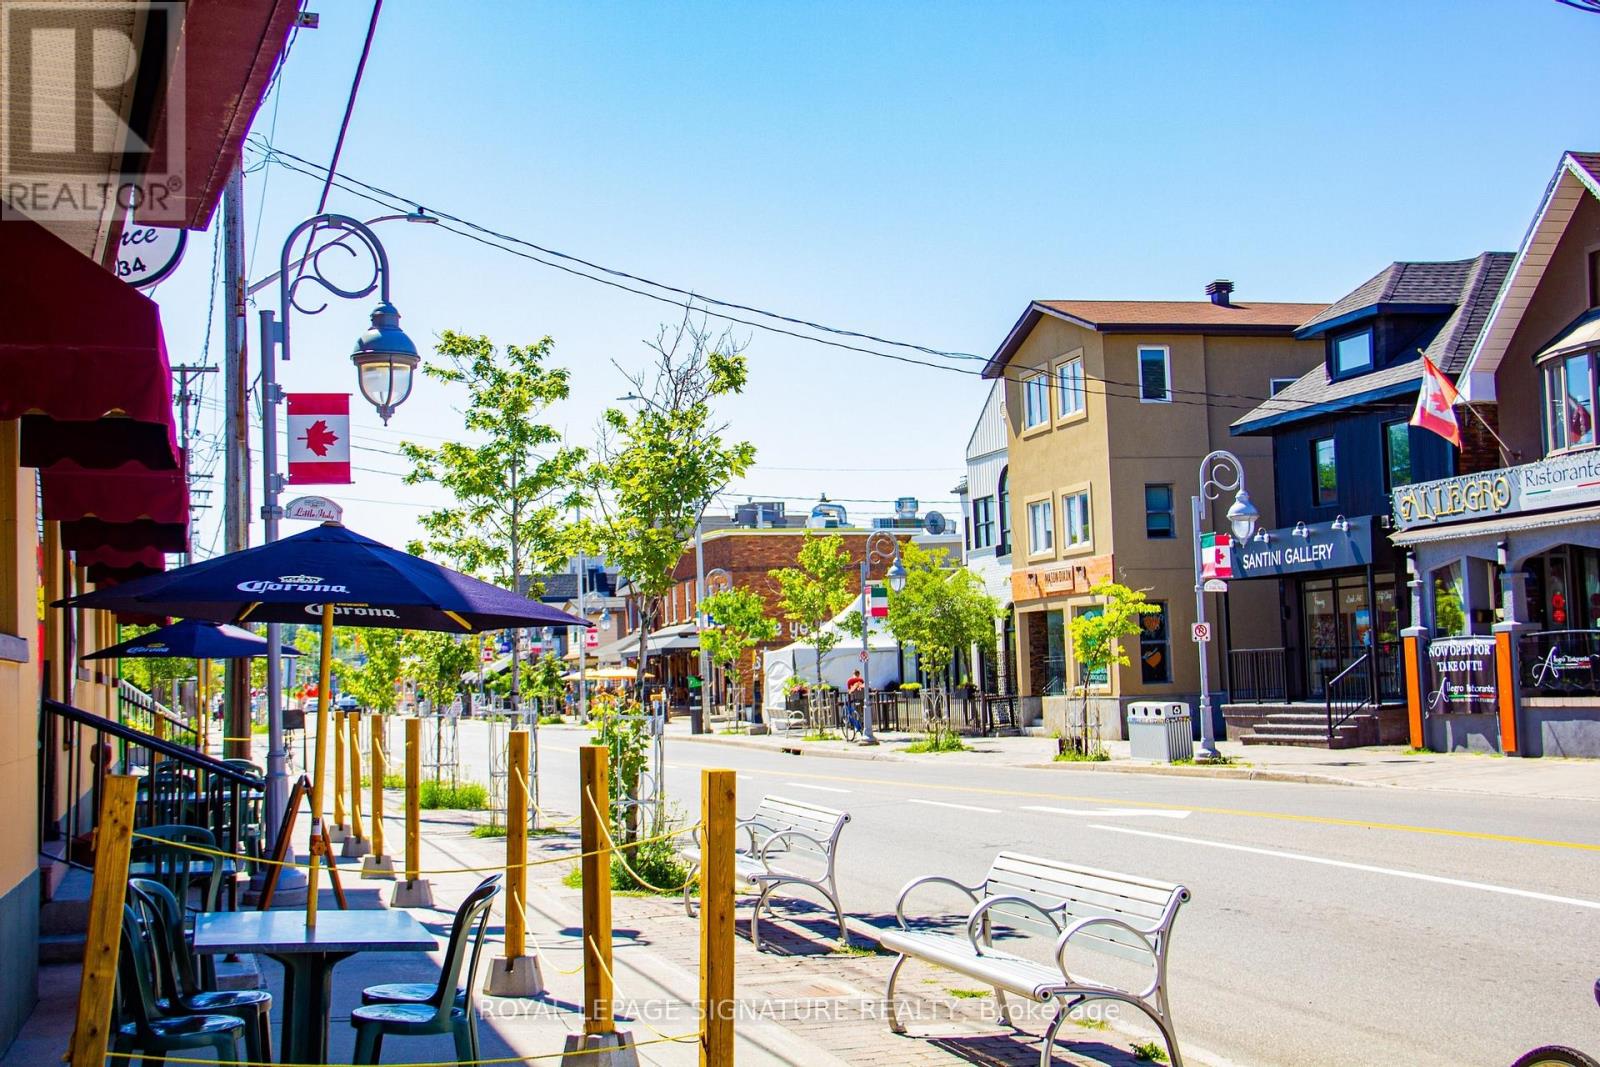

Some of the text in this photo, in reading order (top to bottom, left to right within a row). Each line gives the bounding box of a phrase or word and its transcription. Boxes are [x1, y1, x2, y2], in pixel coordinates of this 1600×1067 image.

[1402, 477, 1510, 521] ALLEGRO
[1525, 460, 1600, 487] Ristorante
[294, 507, 316, 518] Little
[1242, 543, 1334, 570] SANTINI GALLERY
[236, 580, 350, 594] Corona
[304, 602, 401, 619] Corona
[1429, 644, 1491, 657] NOW OPEN FOR
[1436, 660, 1459, 672] TAKE
[1427, 677, 1464, 710] Allegro
